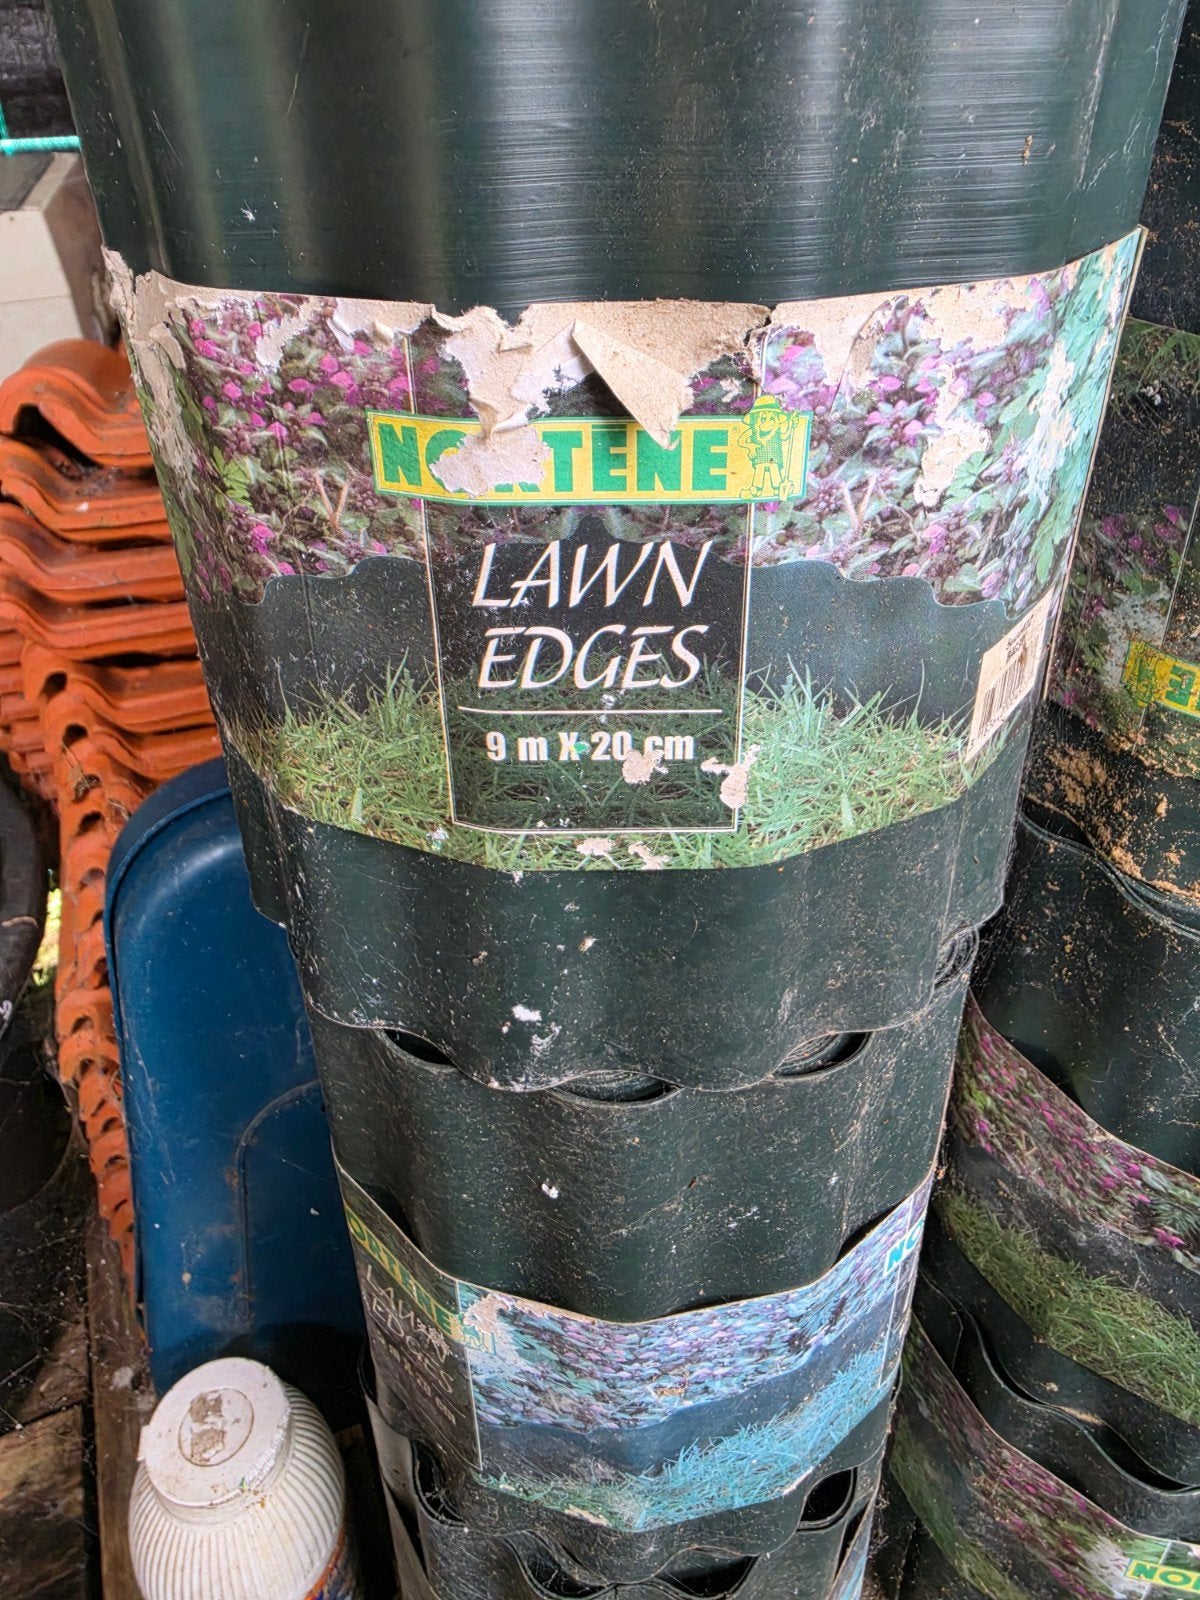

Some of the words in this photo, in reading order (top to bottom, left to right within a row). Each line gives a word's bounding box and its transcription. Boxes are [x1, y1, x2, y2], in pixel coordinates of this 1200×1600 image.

[378, 422, 729, 493] NOTENE
[472, 540, 713, 608] LAWN
[479, 624, 710, 690] EDGES
[486, 731, 508, 761] 9
[517, 736, 550, 761] m
[590, 730, 633, 761] 20
[643, 735, 695, 761] cm
